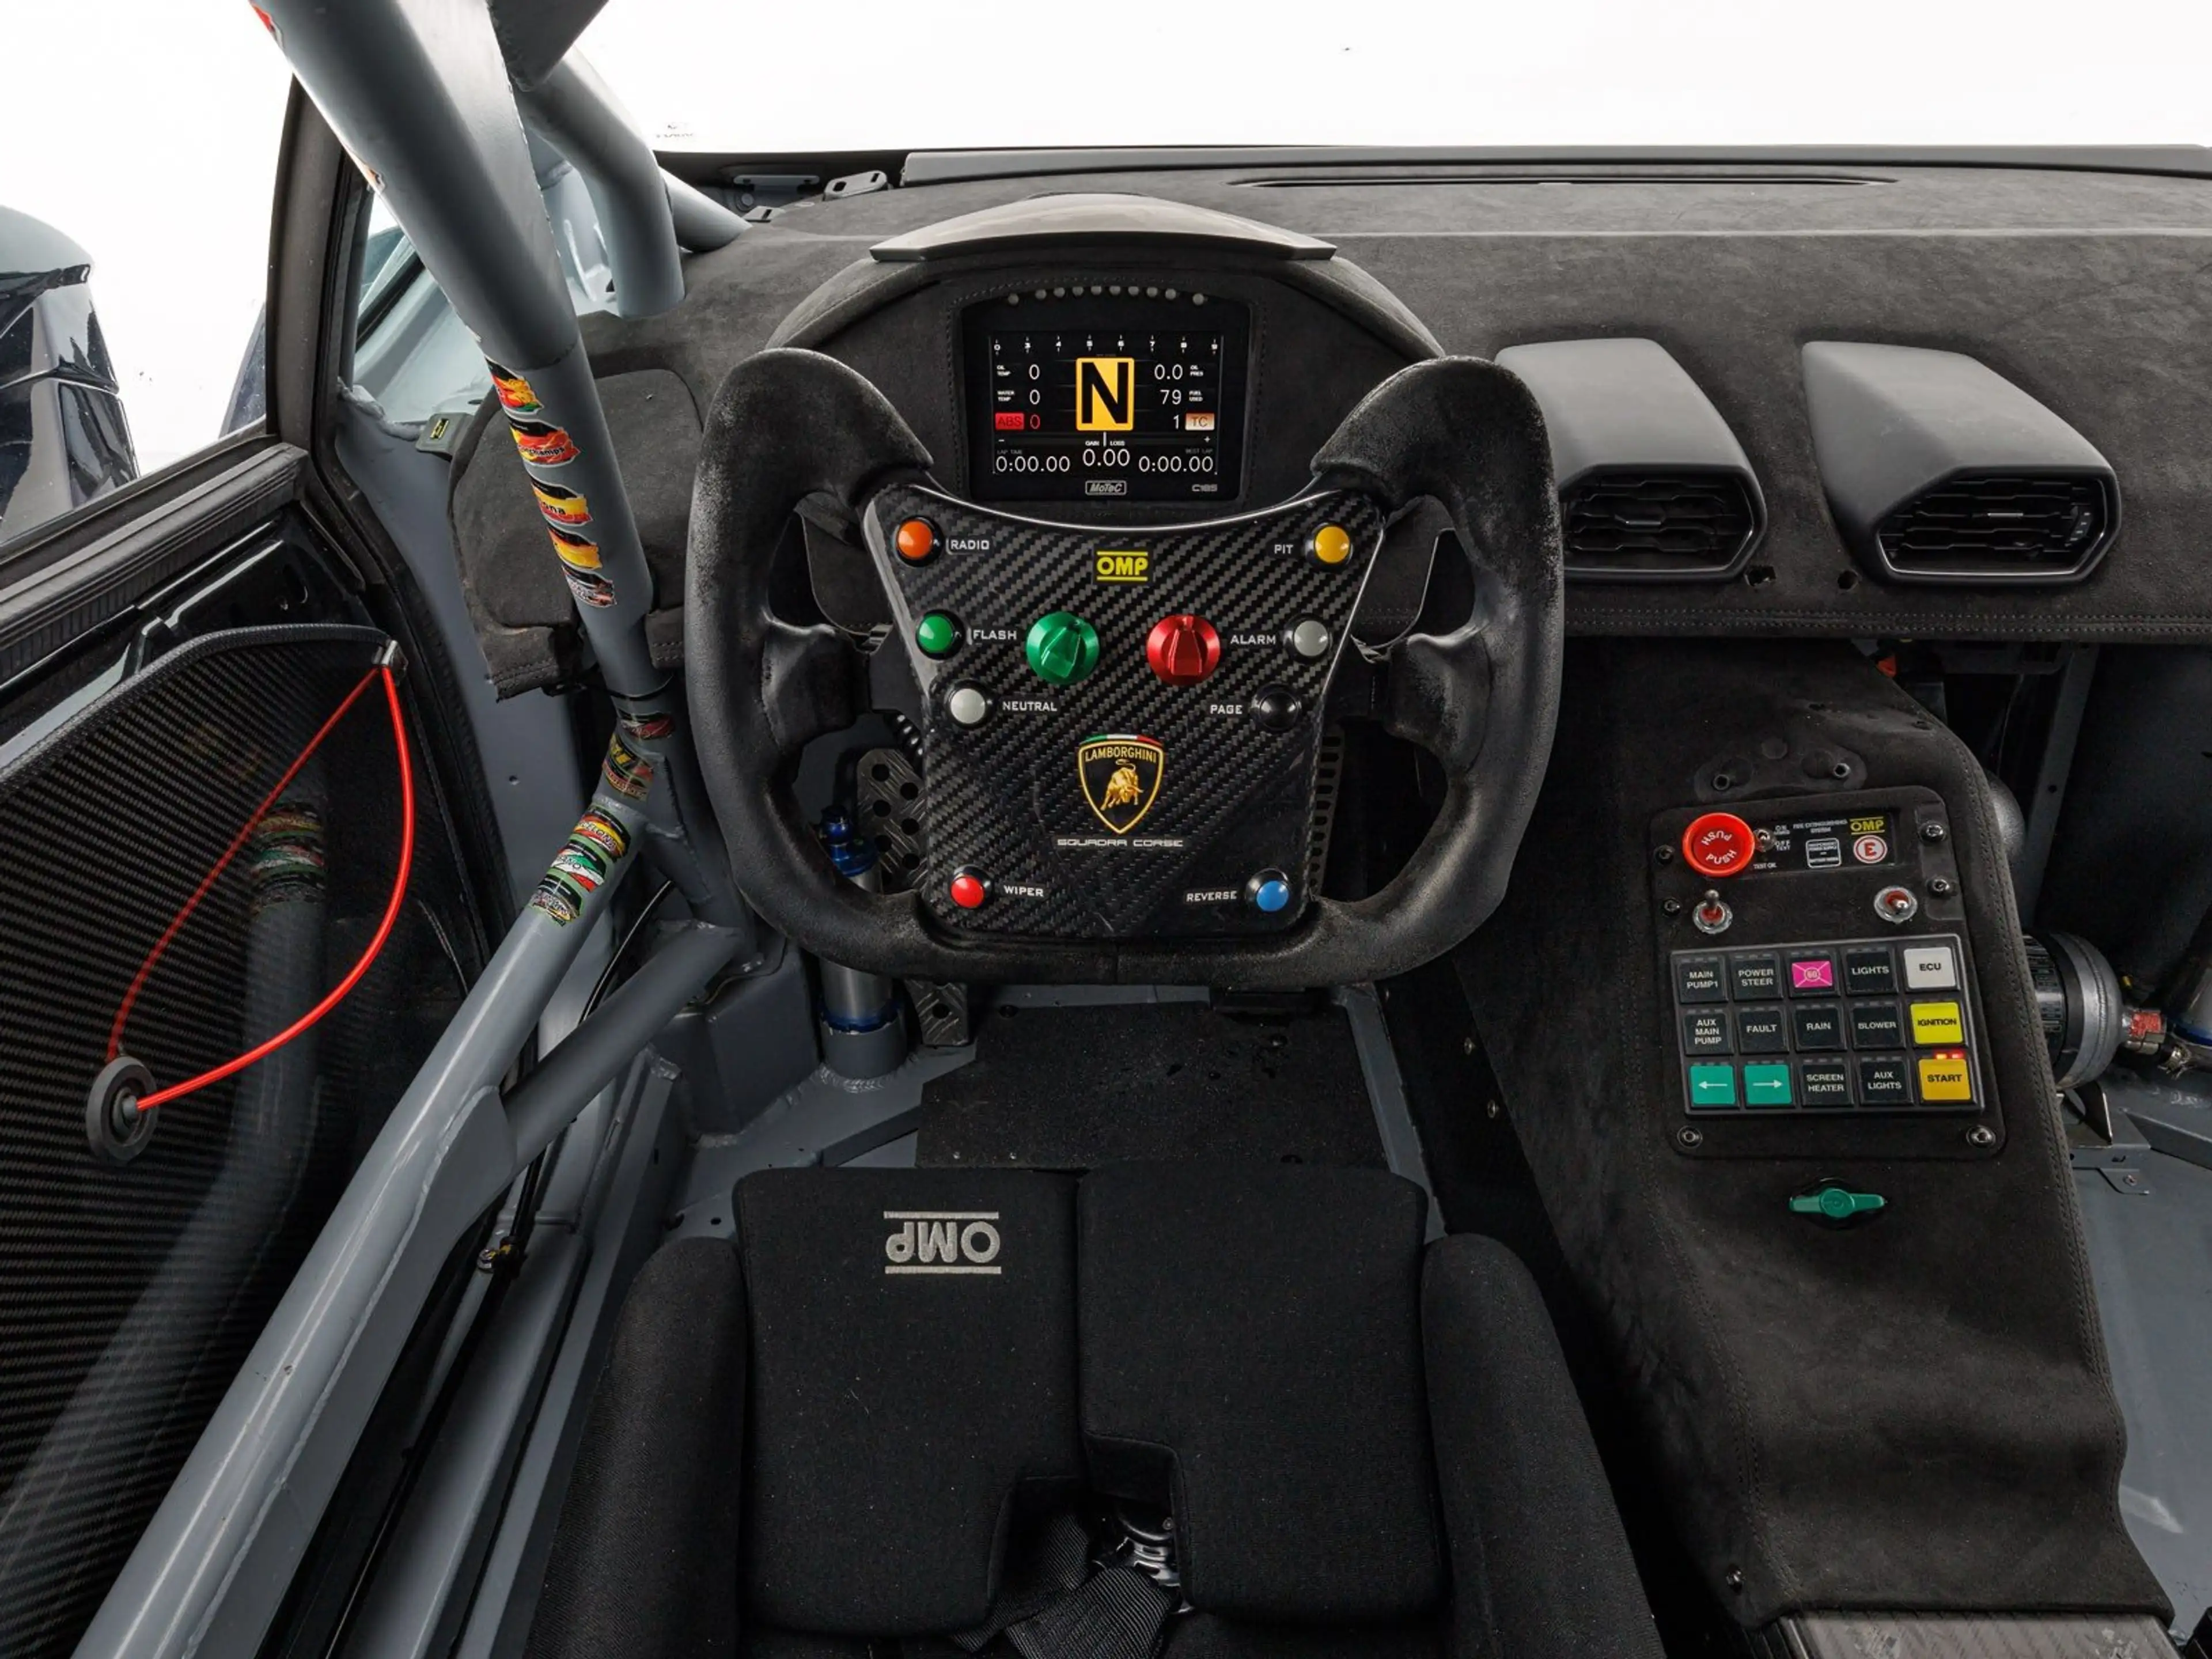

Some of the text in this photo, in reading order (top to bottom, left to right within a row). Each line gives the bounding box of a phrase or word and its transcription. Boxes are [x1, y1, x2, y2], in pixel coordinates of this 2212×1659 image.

[1029, 364, 1040, 380] 0
[1154, 364, 1183, 380] 0.0
[1029, 389, 1040, 404] 0
[1081, 362, 1129, 424] N
[1160, 389, 1181, 404] 79
[998, 416, 1022, 426] ABS
[1029, 414, 1040, 429] 0
[1173, 414, 1179, 429] 1
[1191, 417, 1207, 427] TC
[1083, 449, 1130, 466] 0.00
[996, 456, 1070, 472] 0:00.00
[1139, 456, 1213, 472] 0:00.00
[950, 540, 989, 550] RADIO
[1274, 544, 1293, 554] PIT
[973, 630, 1017, 640] FLASH
[1230, 635, 1276, 645] ALARM
[1002, 701, 1057, 711] NEUTRAL
[1210, 705, 1243, 714] PAGE
[1085, 746, 1156, 763] LAMBORGHINI
[1850, 819, 1884, 831] OMP
[1058, 839, 1183, 847] SQUADRA CORSE
[1701, 830, 1732, 846] PUSH
[1863, 842, 1877, 856] E
[1706, 850, 1737, 864] PUSH
[1003, 885, 1044, 897] WIPER
[1187, 890, 1237, 902] REVERSE
[1851, 965, 1889, 975] LIGHTS
[1919, 963, 1941, 971] ECU
[1689, 971, 1714, 979] MAIN
[1738, 968, 1774, 977] POWER
[1686, 981, 1718, 989] PUMP1
[1696, 1018, 1717, 1027] AUX
[1806, 1022, 1831, 1031] RAIN
[1858, 1022, 1897, 1030] BLOWER
[1917, 1018, 1957, 1027] IGNITION
[1695, 1028, 1719, 1036] MAIN
[1746, 1024, 1778, 1033] FAULT
[1694, 1037, 1722, 1045] PUMP
[1806, 1074, 1844, 1082] SCREEN
[1873, 1071, 1894, 1079] AUX
[1927, 1074, 1963, 1083] START
[1808, 1084, 1844, 1092] HEATER
[1868, 1081, 1902, 1090] LIGHTS
[885, 1221, 1001, 1263] OMP
